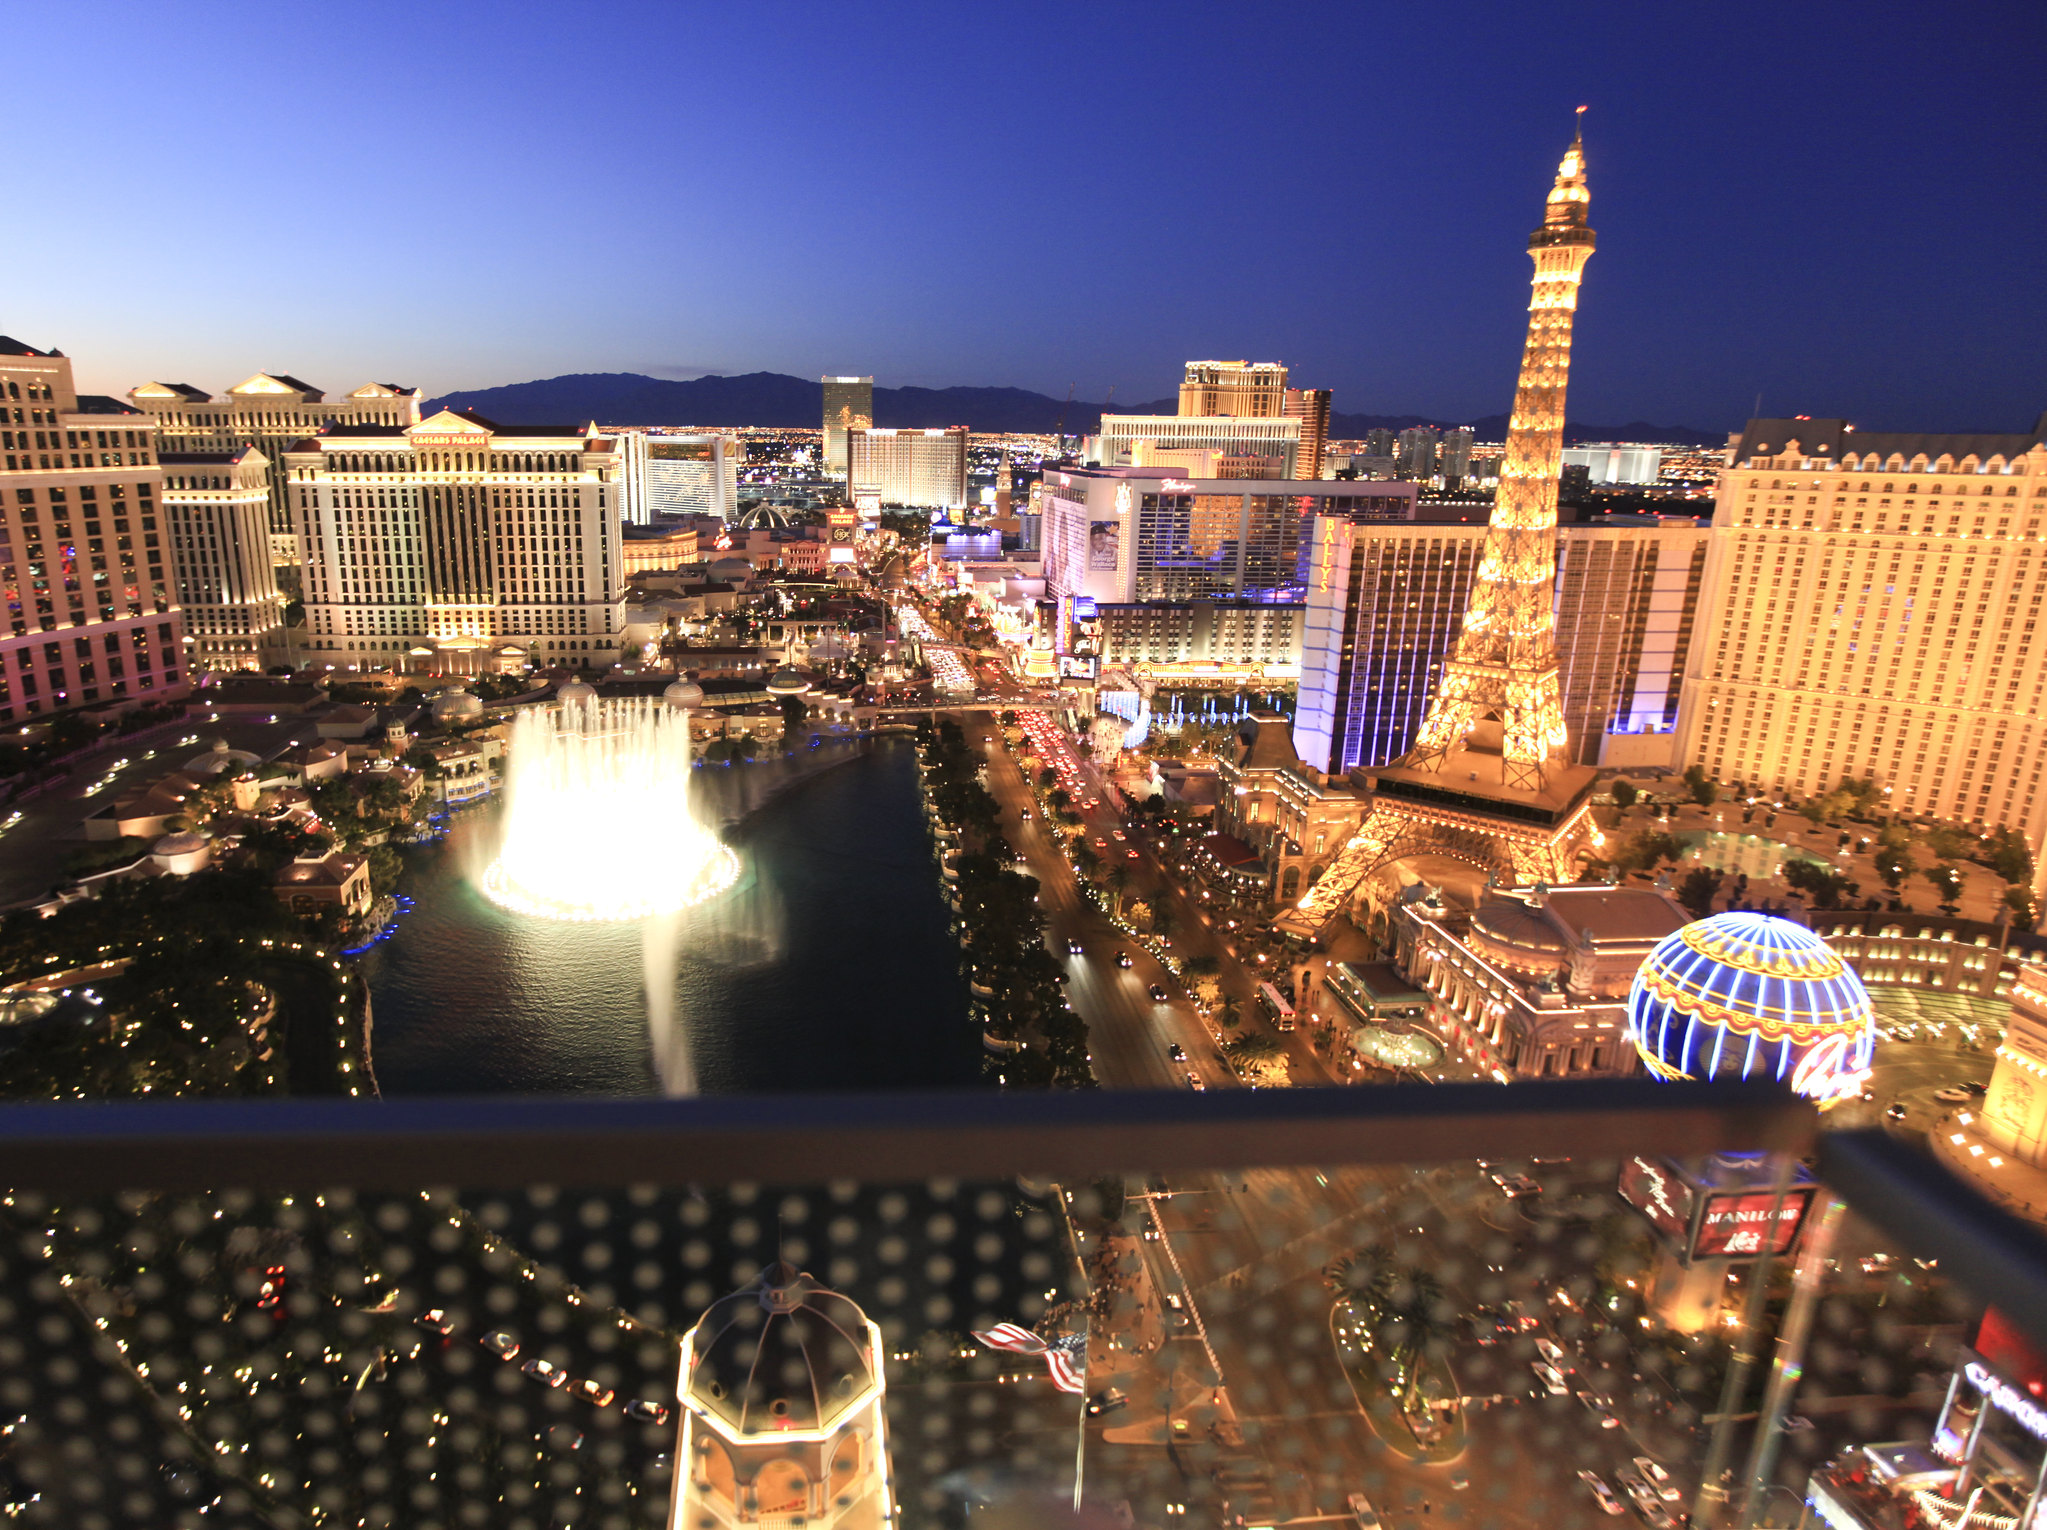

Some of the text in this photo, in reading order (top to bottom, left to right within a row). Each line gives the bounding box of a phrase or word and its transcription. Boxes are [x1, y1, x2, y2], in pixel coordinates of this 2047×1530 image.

[412, 436, 485, 445] CAESARS PALACE
[1706, 1208, 1800, 1225] MANILOW
